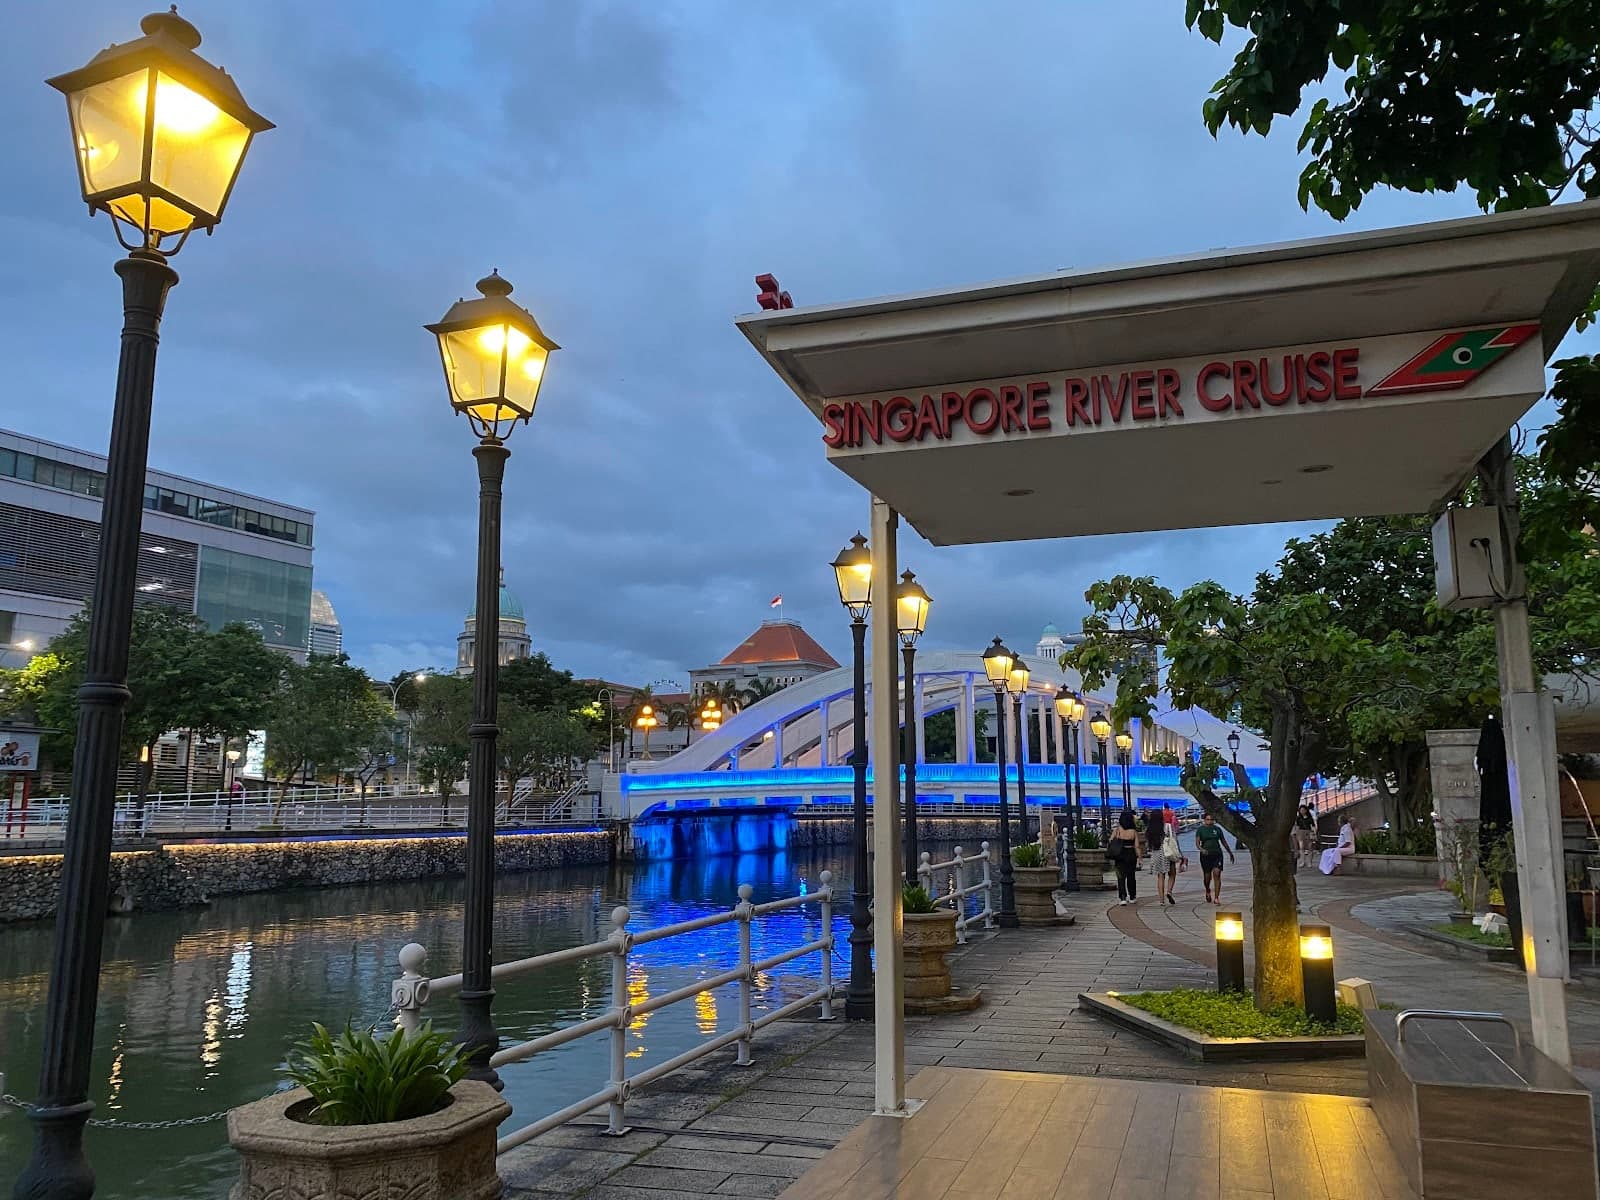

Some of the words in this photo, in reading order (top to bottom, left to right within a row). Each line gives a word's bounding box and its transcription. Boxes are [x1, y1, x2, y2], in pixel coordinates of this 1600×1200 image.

[822, 382, 1050, 448] SINGAPORE
[1065, 369, 1184, 426] RIVER
[1196, 348, 1361, 412] CRUISE
